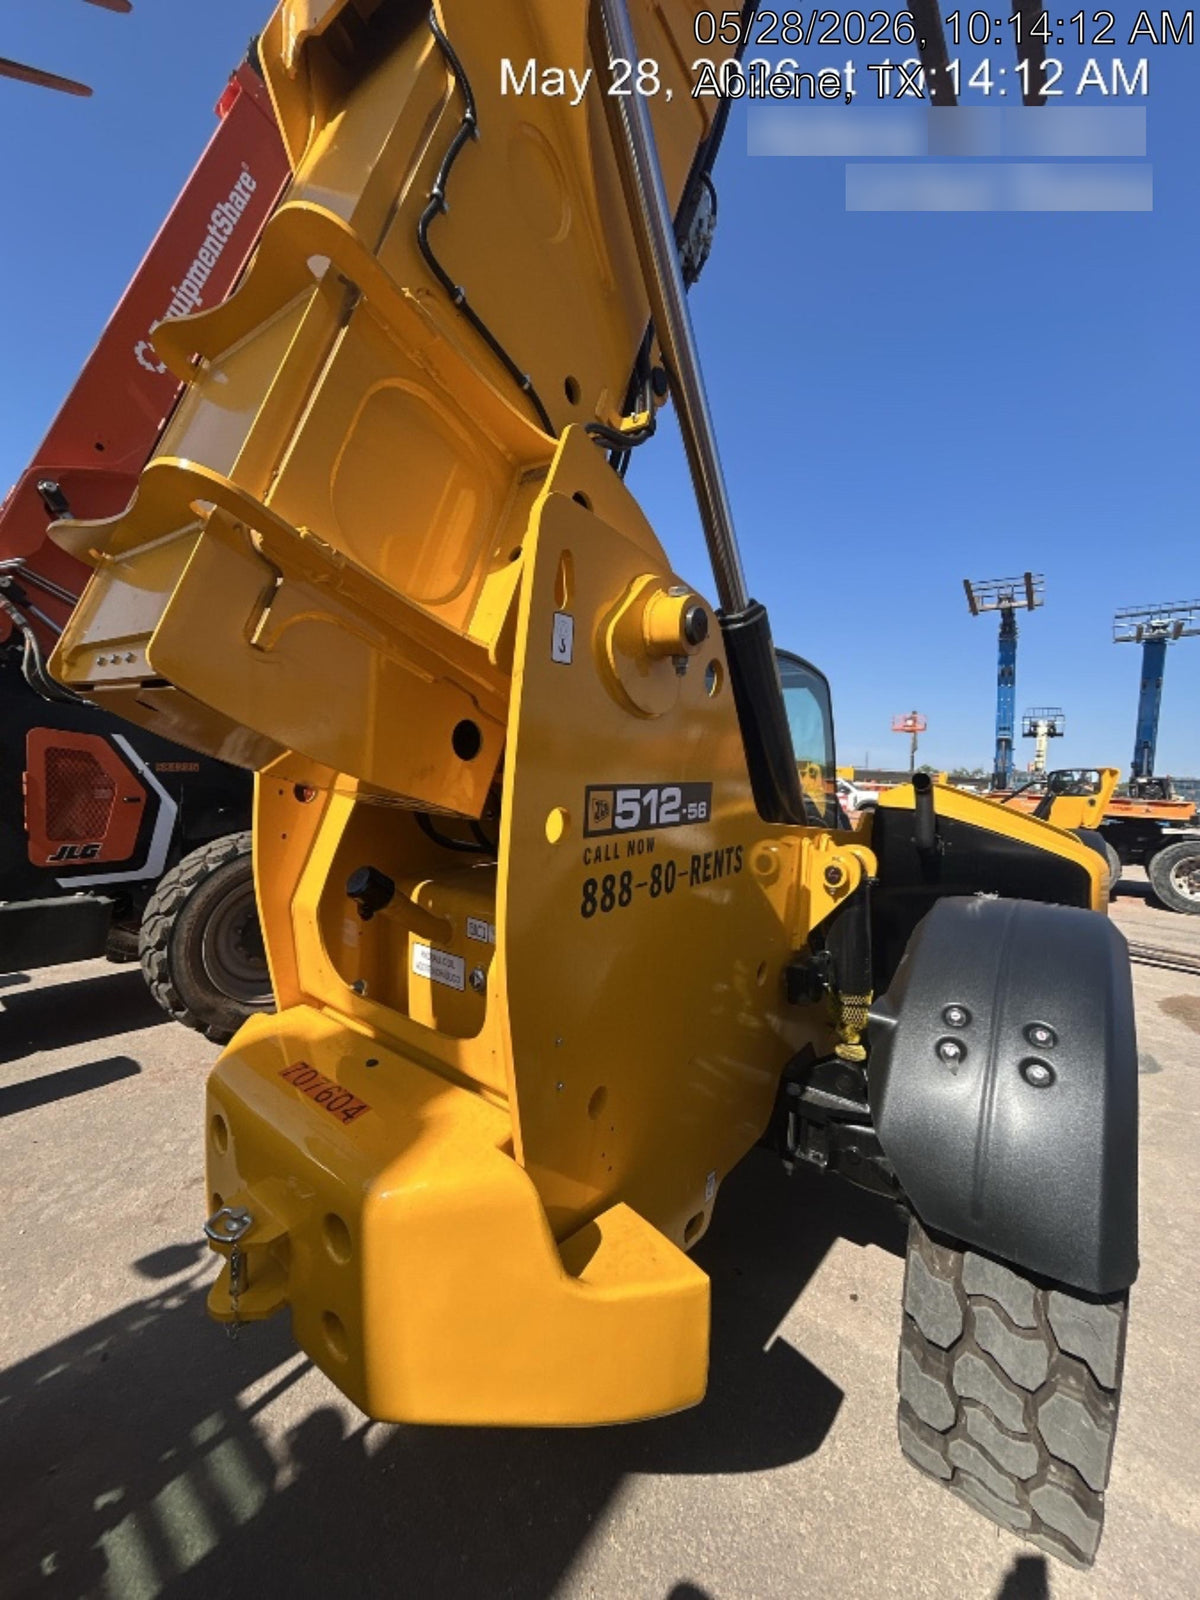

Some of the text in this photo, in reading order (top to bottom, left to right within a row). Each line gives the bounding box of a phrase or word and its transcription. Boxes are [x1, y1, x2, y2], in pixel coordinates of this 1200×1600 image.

[149, 170, 256, 334] uipmentShare
[46, 842, 104, 863] JLG
[580, 844, 744, 919] 888-80-RENTS
[583, 837, 656, 866] CALL NOW
[282, 1061, 368, 1124] 707604
